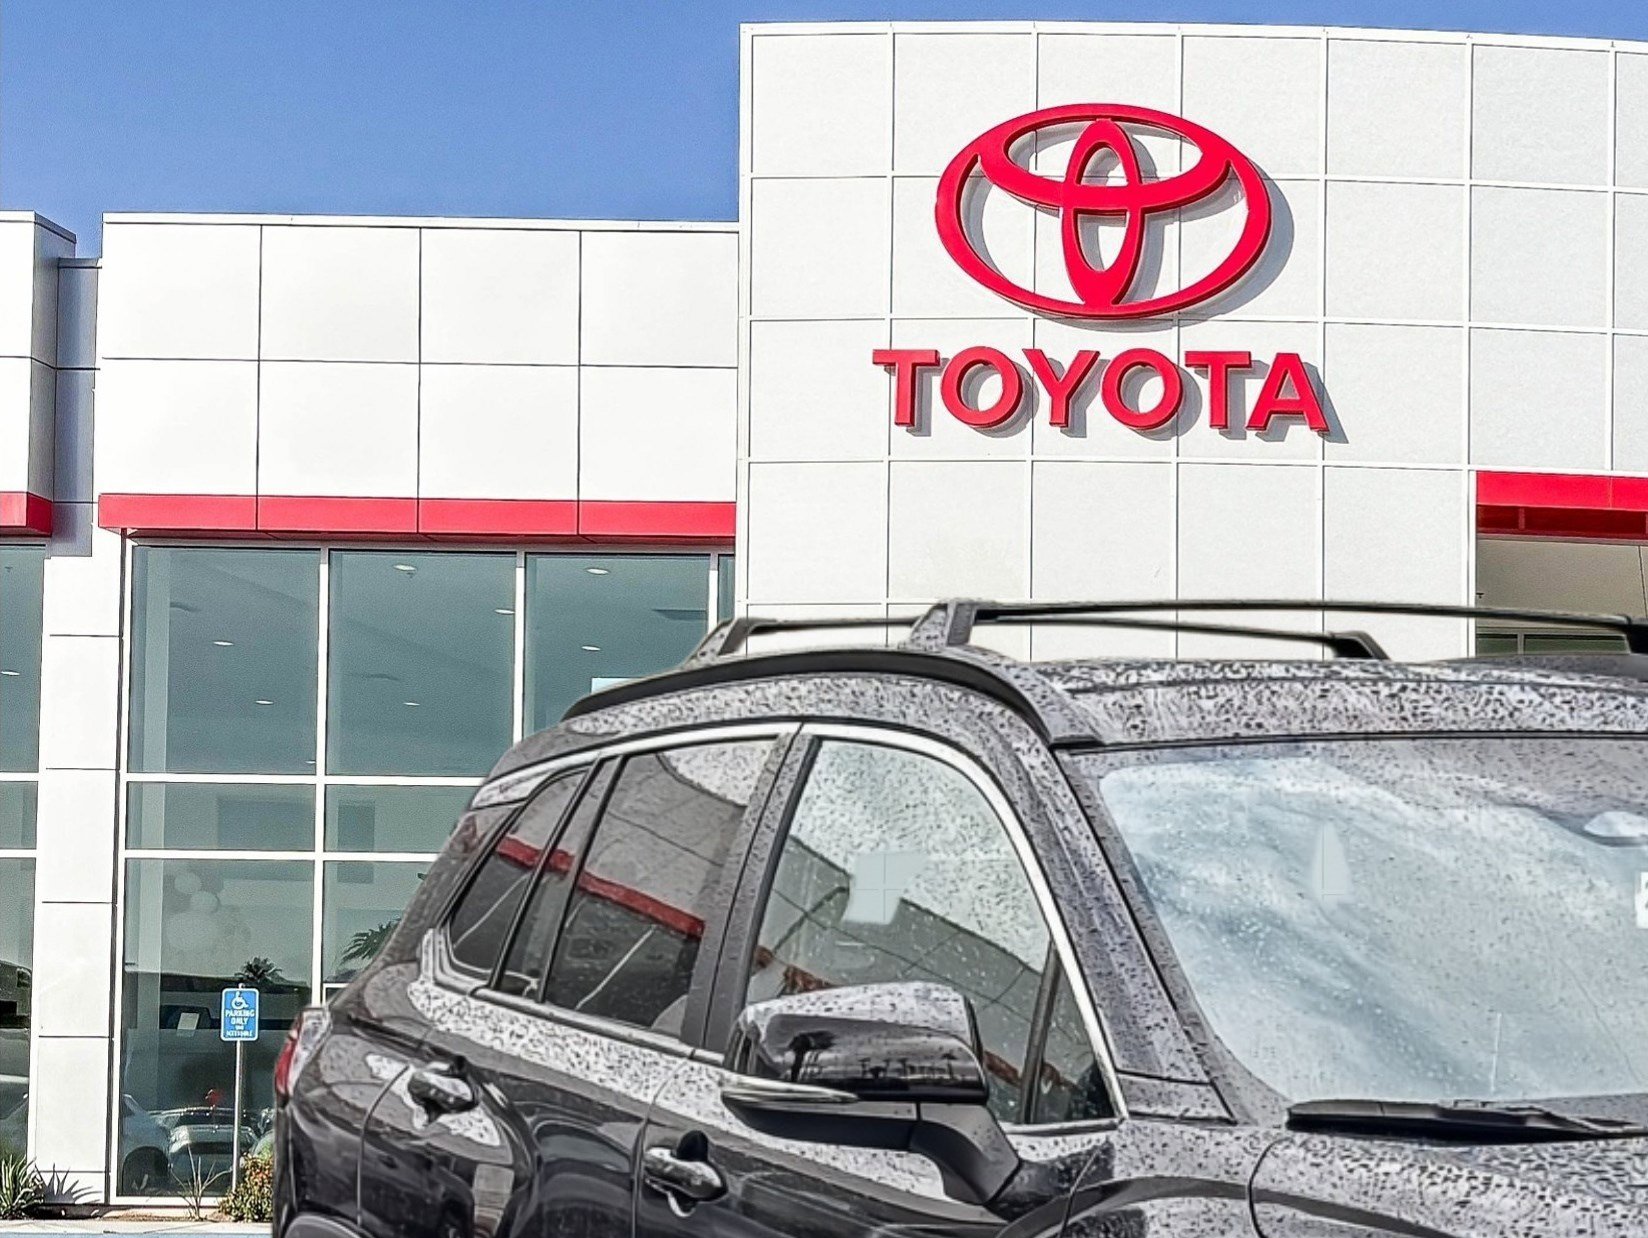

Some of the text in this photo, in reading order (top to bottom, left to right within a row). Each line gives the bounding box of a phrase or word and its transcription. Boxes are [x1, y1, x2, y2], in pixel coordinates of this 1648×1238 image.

[872, 346, 1329, 432] TOYOTA
[225, 1009, 255, 1018] PARKING
[230, 1017, 249, 1025] ONLY
